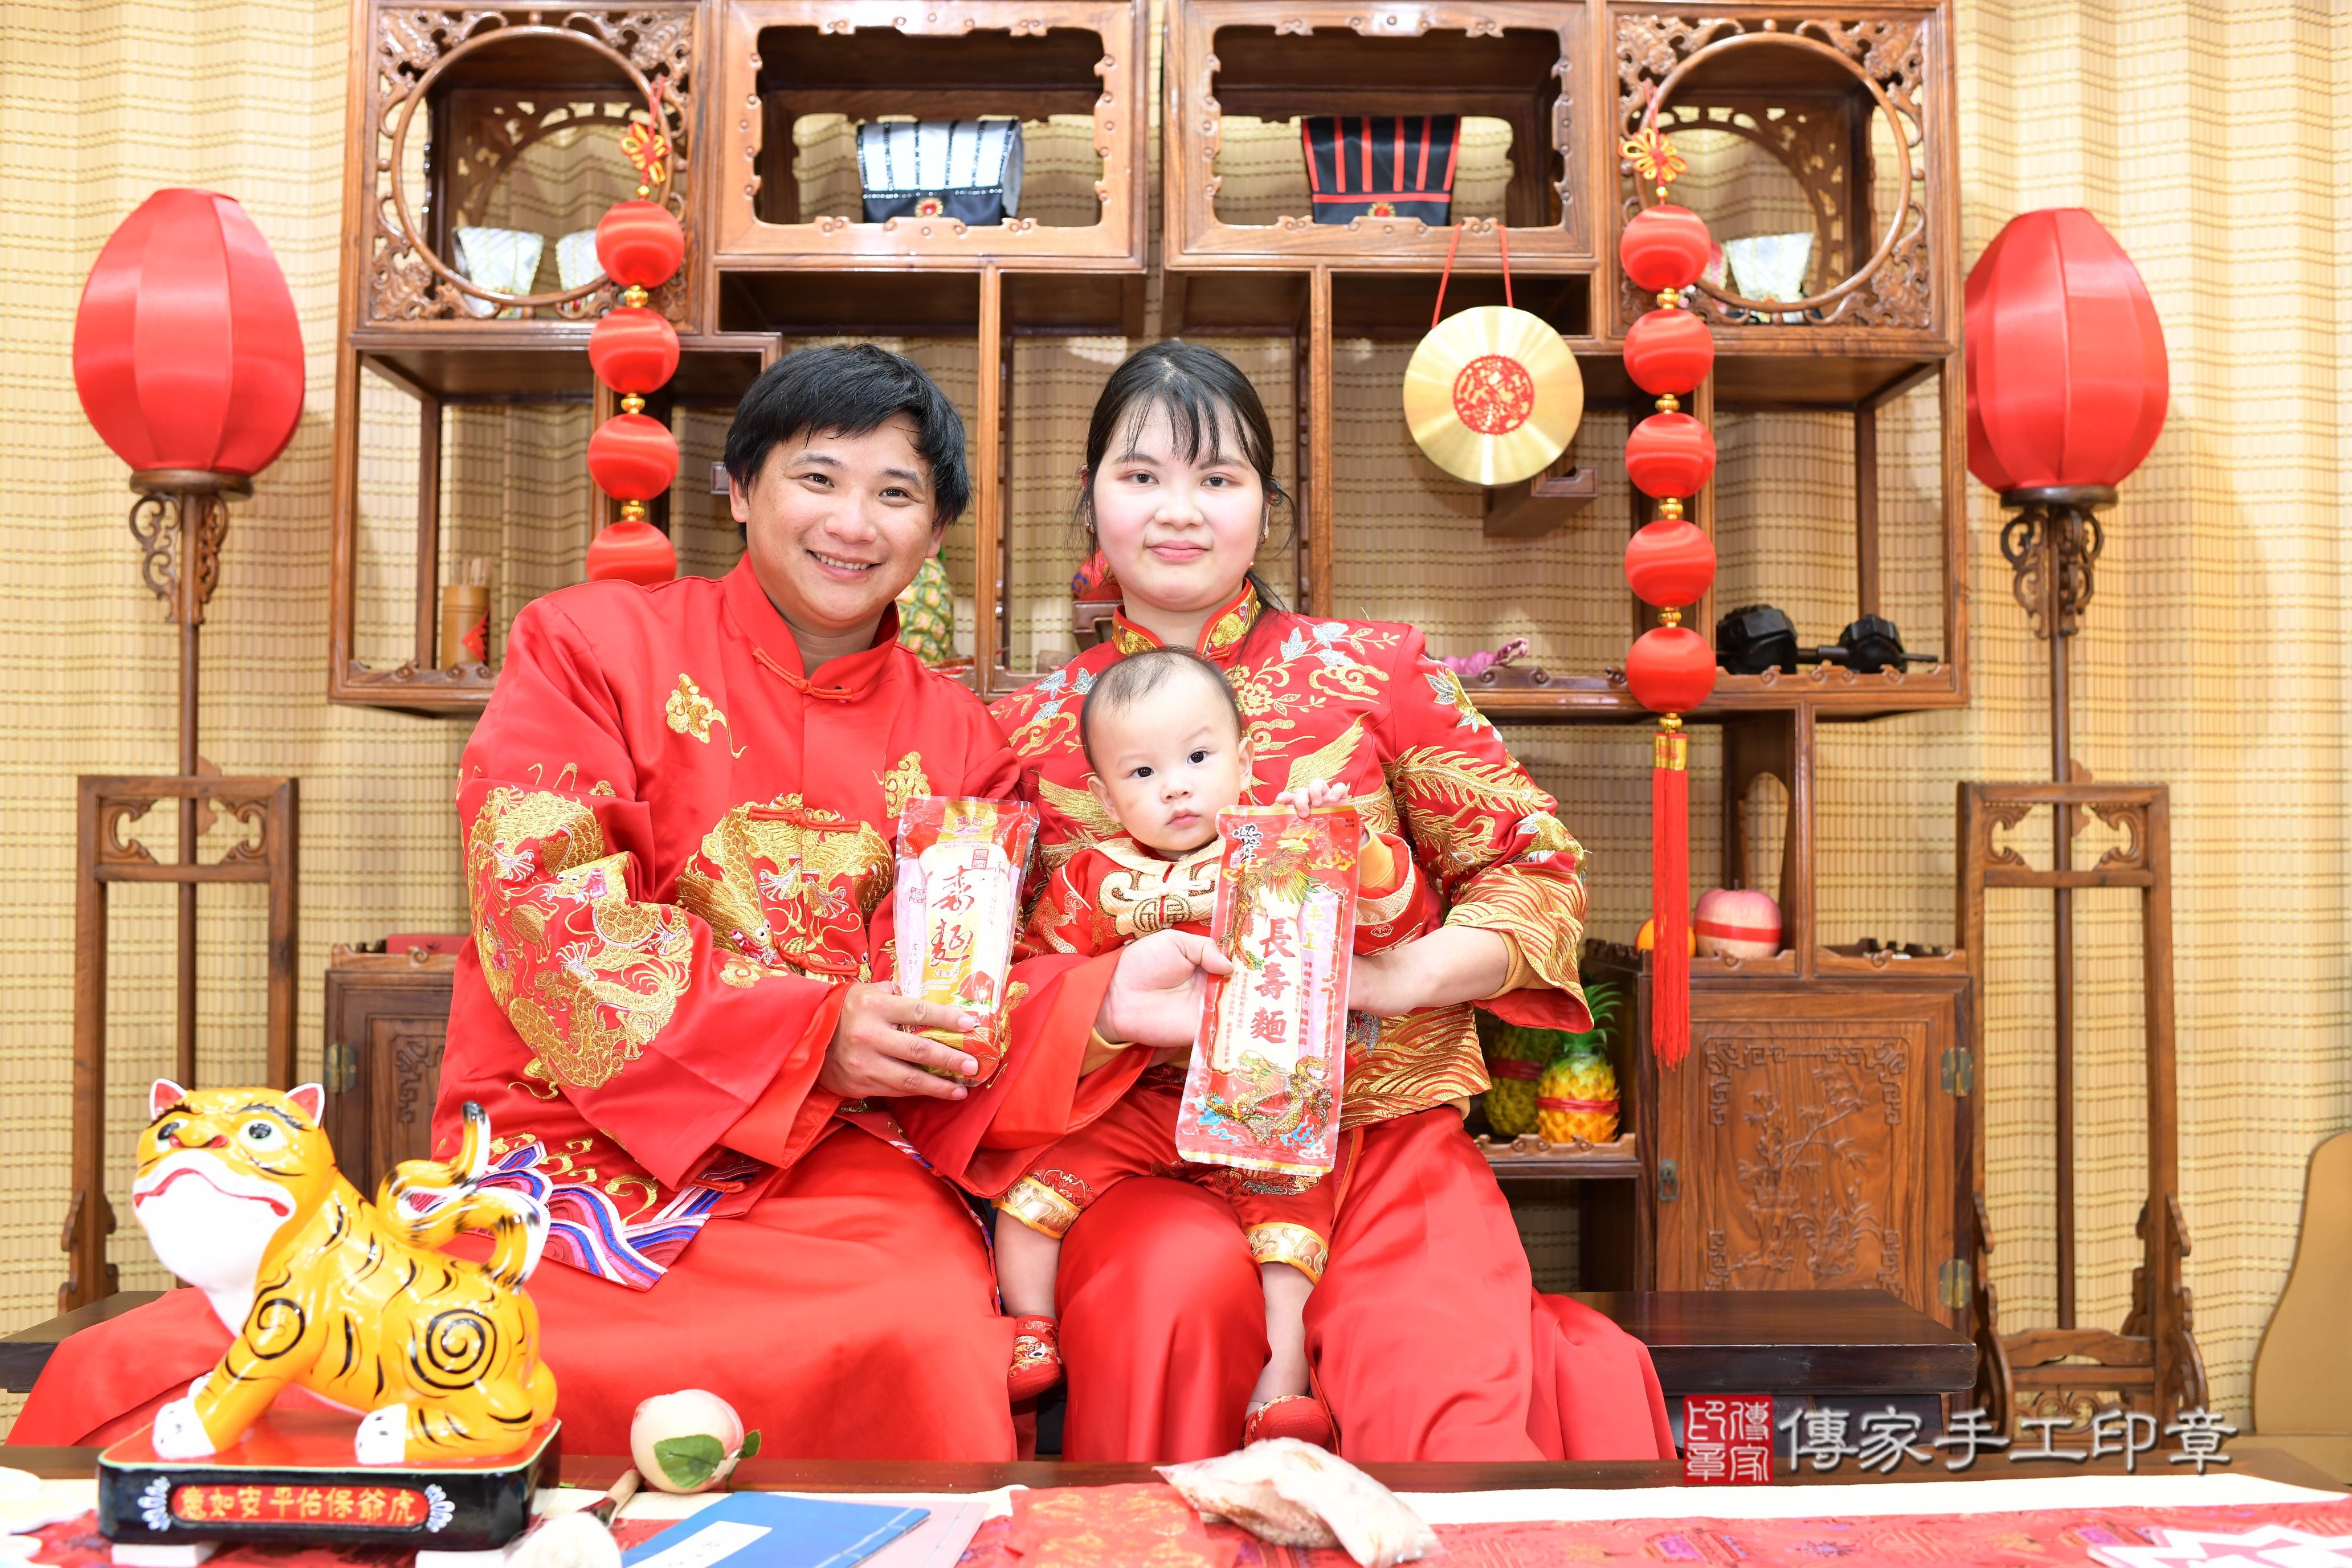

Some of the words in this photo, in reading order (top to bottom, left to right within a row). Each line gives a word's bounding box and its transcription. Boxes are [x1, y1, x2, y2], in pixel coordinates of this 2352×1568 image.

[957, 815, 983, 827] 龍口
[1301, 904, 1325, 950] 手工
[1250, 917, 1295, 1045] 長壽麵
